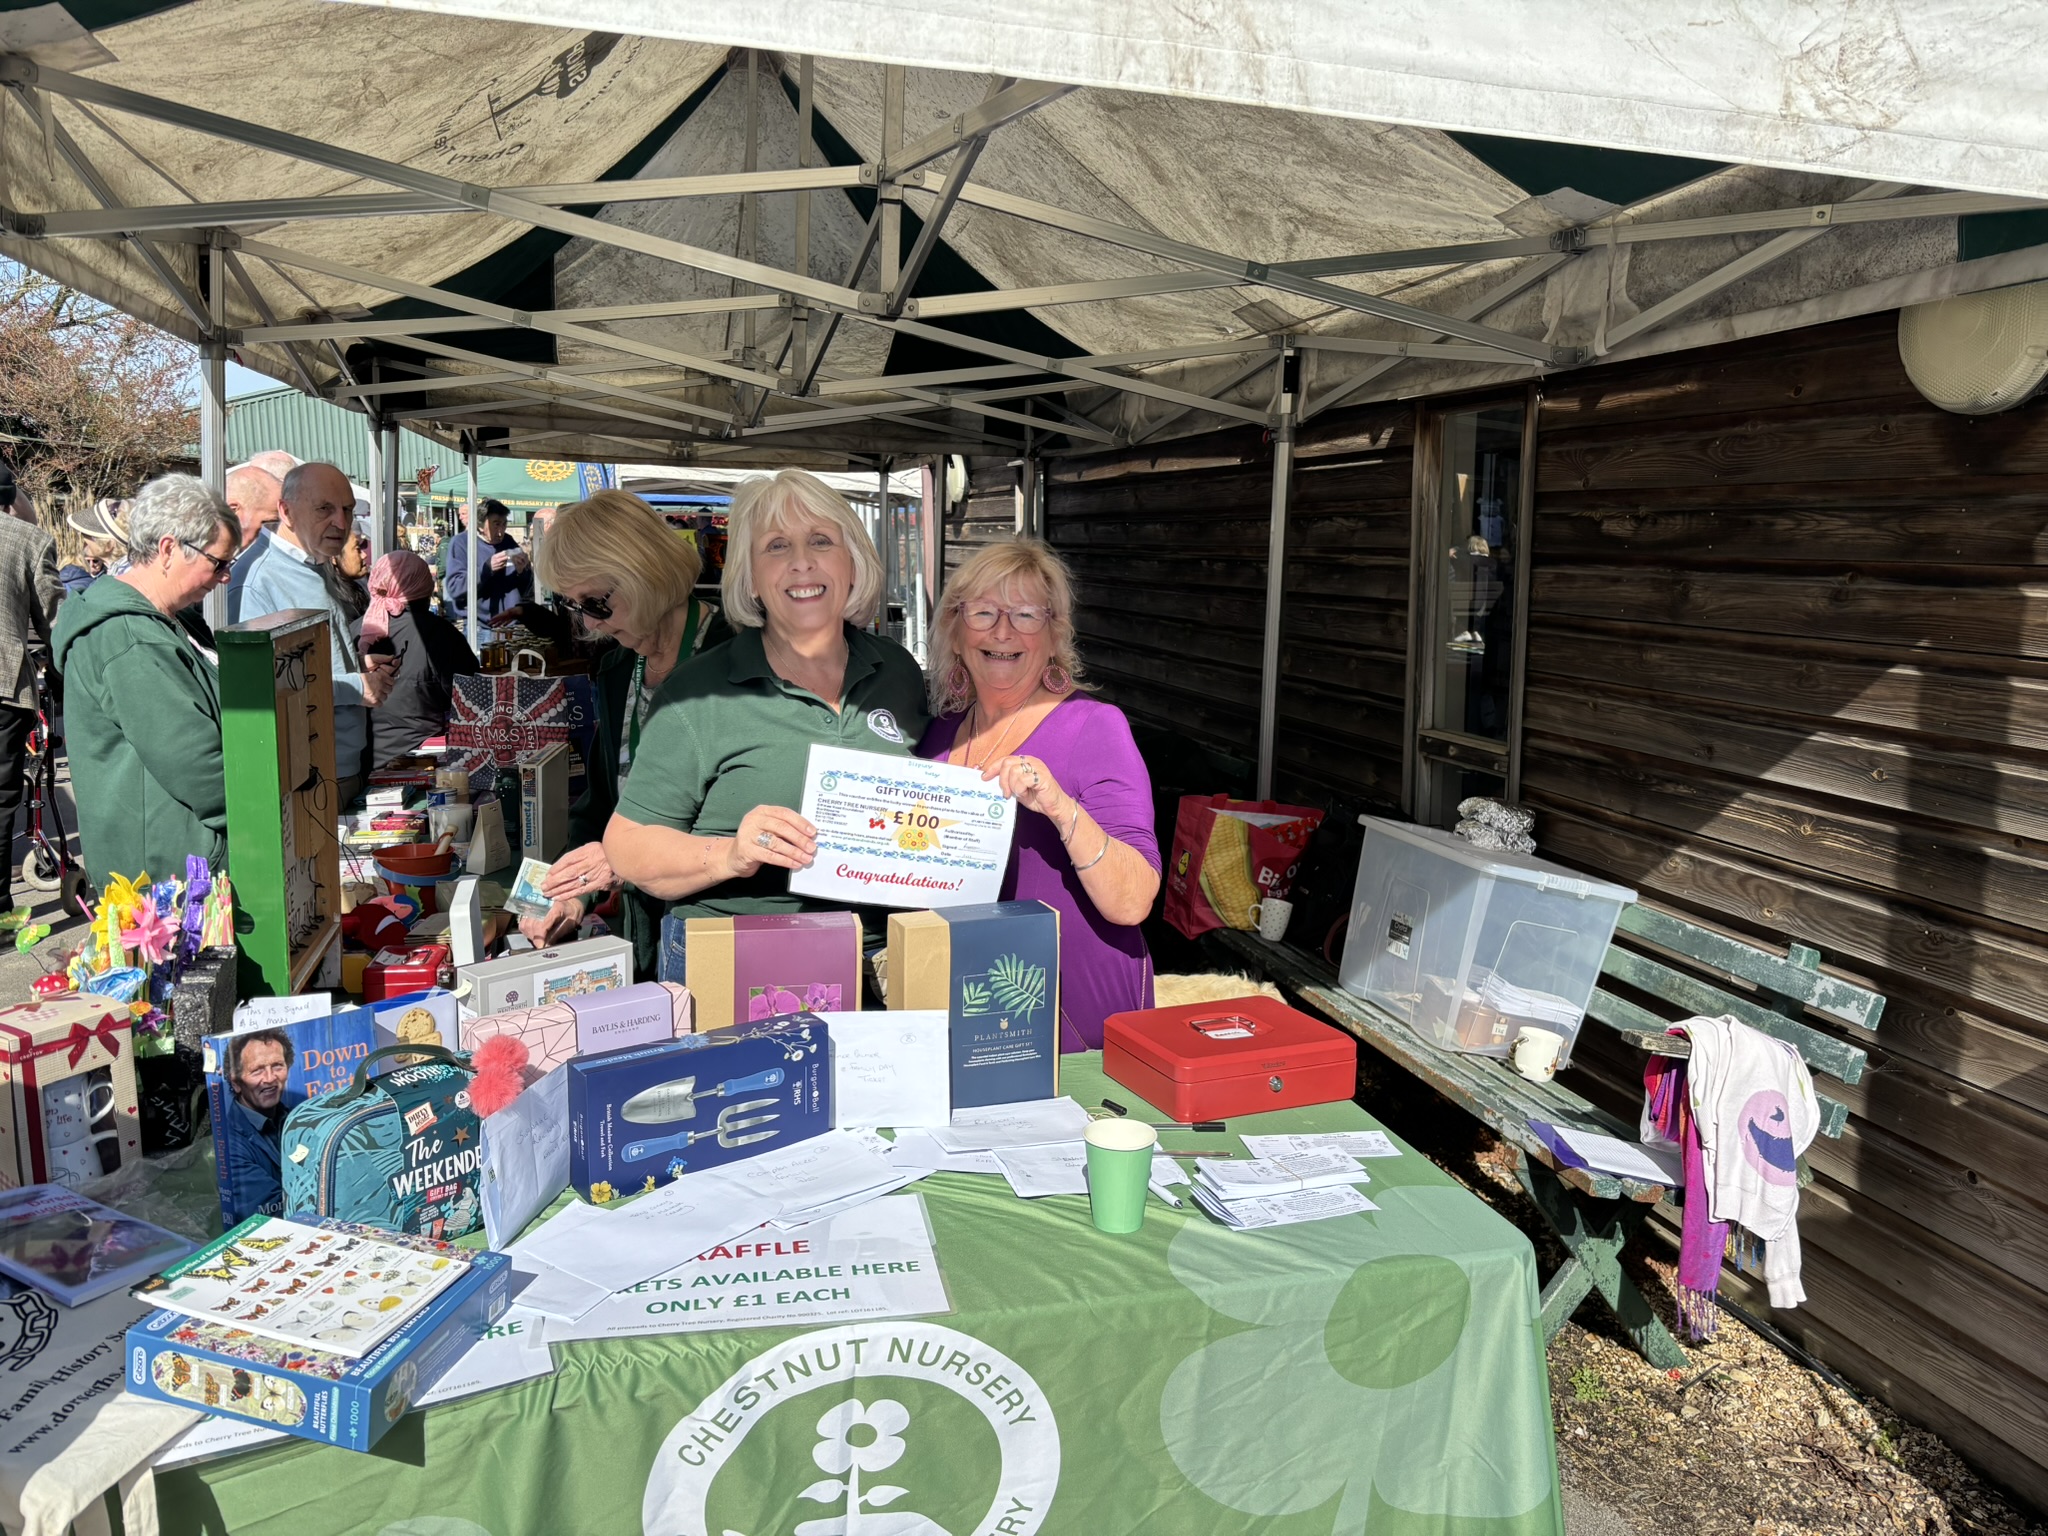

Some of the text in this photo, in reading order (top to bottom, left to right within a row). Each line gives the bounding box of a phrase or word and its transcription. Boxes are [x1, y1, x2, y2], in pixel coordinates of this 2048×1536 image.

[474, 705, 513, 747] SUPPORTING
[487, 728, 520, 743] M&S
[514, 711, 536, 749] BRITISH
[818, 798, 889, 812] CHERRY TREE NURSERY
[875, 785, 951, 804] GIFT VOUCHER
[524, 810, 533, 847] Connect
[893, 810, 940, 829] £100
[836, 863, 964, 891] Congratulations!
[496, 1003, 528, 1014] WENTWORTH
[591, 1021, 619, 1035] BAYLIS
[626, 1013, 662, 1028] HARDING
[974, 1029, 1033, 1041] PLANTSMITH
[301, 1041, 370, 1072] Down
[329, 1065, 347, 1079] to
[793, 1088, 802, 1106] RHS
[210, 1082, 222, 1123] Down
[217, 1139, 229, 1181] Earth
[405, 1136, 443, 1168] The
[393, 1145, 482, 1200] WEEKENDE
[26, 1193, 77, 1208] Dorset
[429, 1183, 458, 1197] GIFT BAG
[168, 1258, 200, 1278] Butterflies
[206, 1241, 228, 1257] Britain
[237, 1222, 258, 1241] Ireland
[482, 1255, 503, 1271] 1000
[691, 1260, 921, 1288] AVAILABLE HERE
[645, 1287, 851, 1314] ONLY £1 EACH
[617, 1324, 648, 1332] proceeds
[726, 1315, 762, 1323] Registered
[134, 1349, 144, 1381] Gibsons
[350, 1341, 392, 1377] BEAUTIFUL
[1, 1378, 57, 1422] Family
[50, 1341, 113, 1384] History
[312, 1392, 321, 1429] BEAUTIFUL
[319, 1390, 329, 1434] BUTTERFLIES
[350, 1400, 360, 1426] 1000
[677, 1336, 1038, 1467] CHESTNUT NURSERY
[205, 1433, 232, 1445] Cherry
[233, 1429, 252, 1438] Tree
